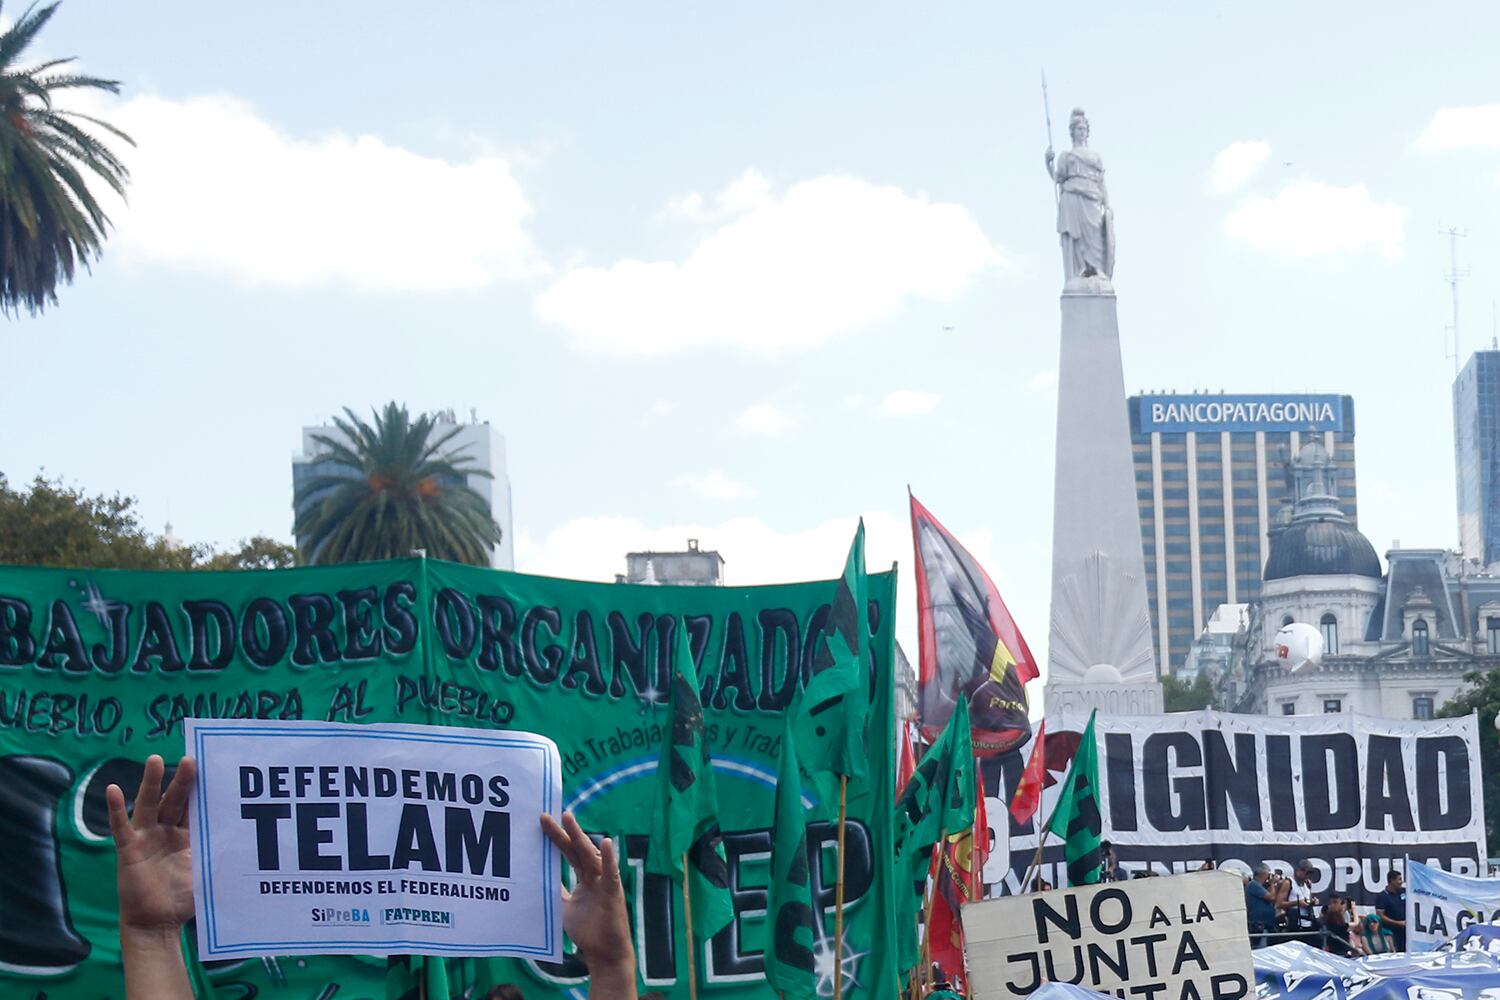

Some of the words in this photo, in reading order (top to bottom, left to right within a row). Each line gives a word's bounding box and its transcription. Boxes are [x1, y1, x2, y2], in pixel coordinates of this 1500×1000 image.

[1152, 402, 1336, 423] BANCOPATAGONIA
[0, 580, 420, 673] BAJADORES
[434, 587, 882, 713] ORGANIZADO
[327, 678, 374, 722] AL
[396, 674, 515, 725] PUEBLO
[564, 751, 589, 776] de
[725, 725, 740, 747] y
[744, 723, 783, 760] Trab
[239, 766, 510, 807] DEFENDEMOS
[1104, 730, 1472, 832] IGNIDAD
[241, 802, 511, 878] TELAM
[260, 880, 373, 895] DEFENDEMOS
[378, 881, 397, 894] EL
[400, 880, 510, 902] FEDERALISMO
[311, 907, 370, 922] SiPreBA
[1032, 888, 1133, 944] NO
[1150, 905, 1172, 929] A
[1179, 900, 1214, 925] LA
[1414, 902, 1449, 937] LA
[1005, 930, 1209, 996] JUNTA
